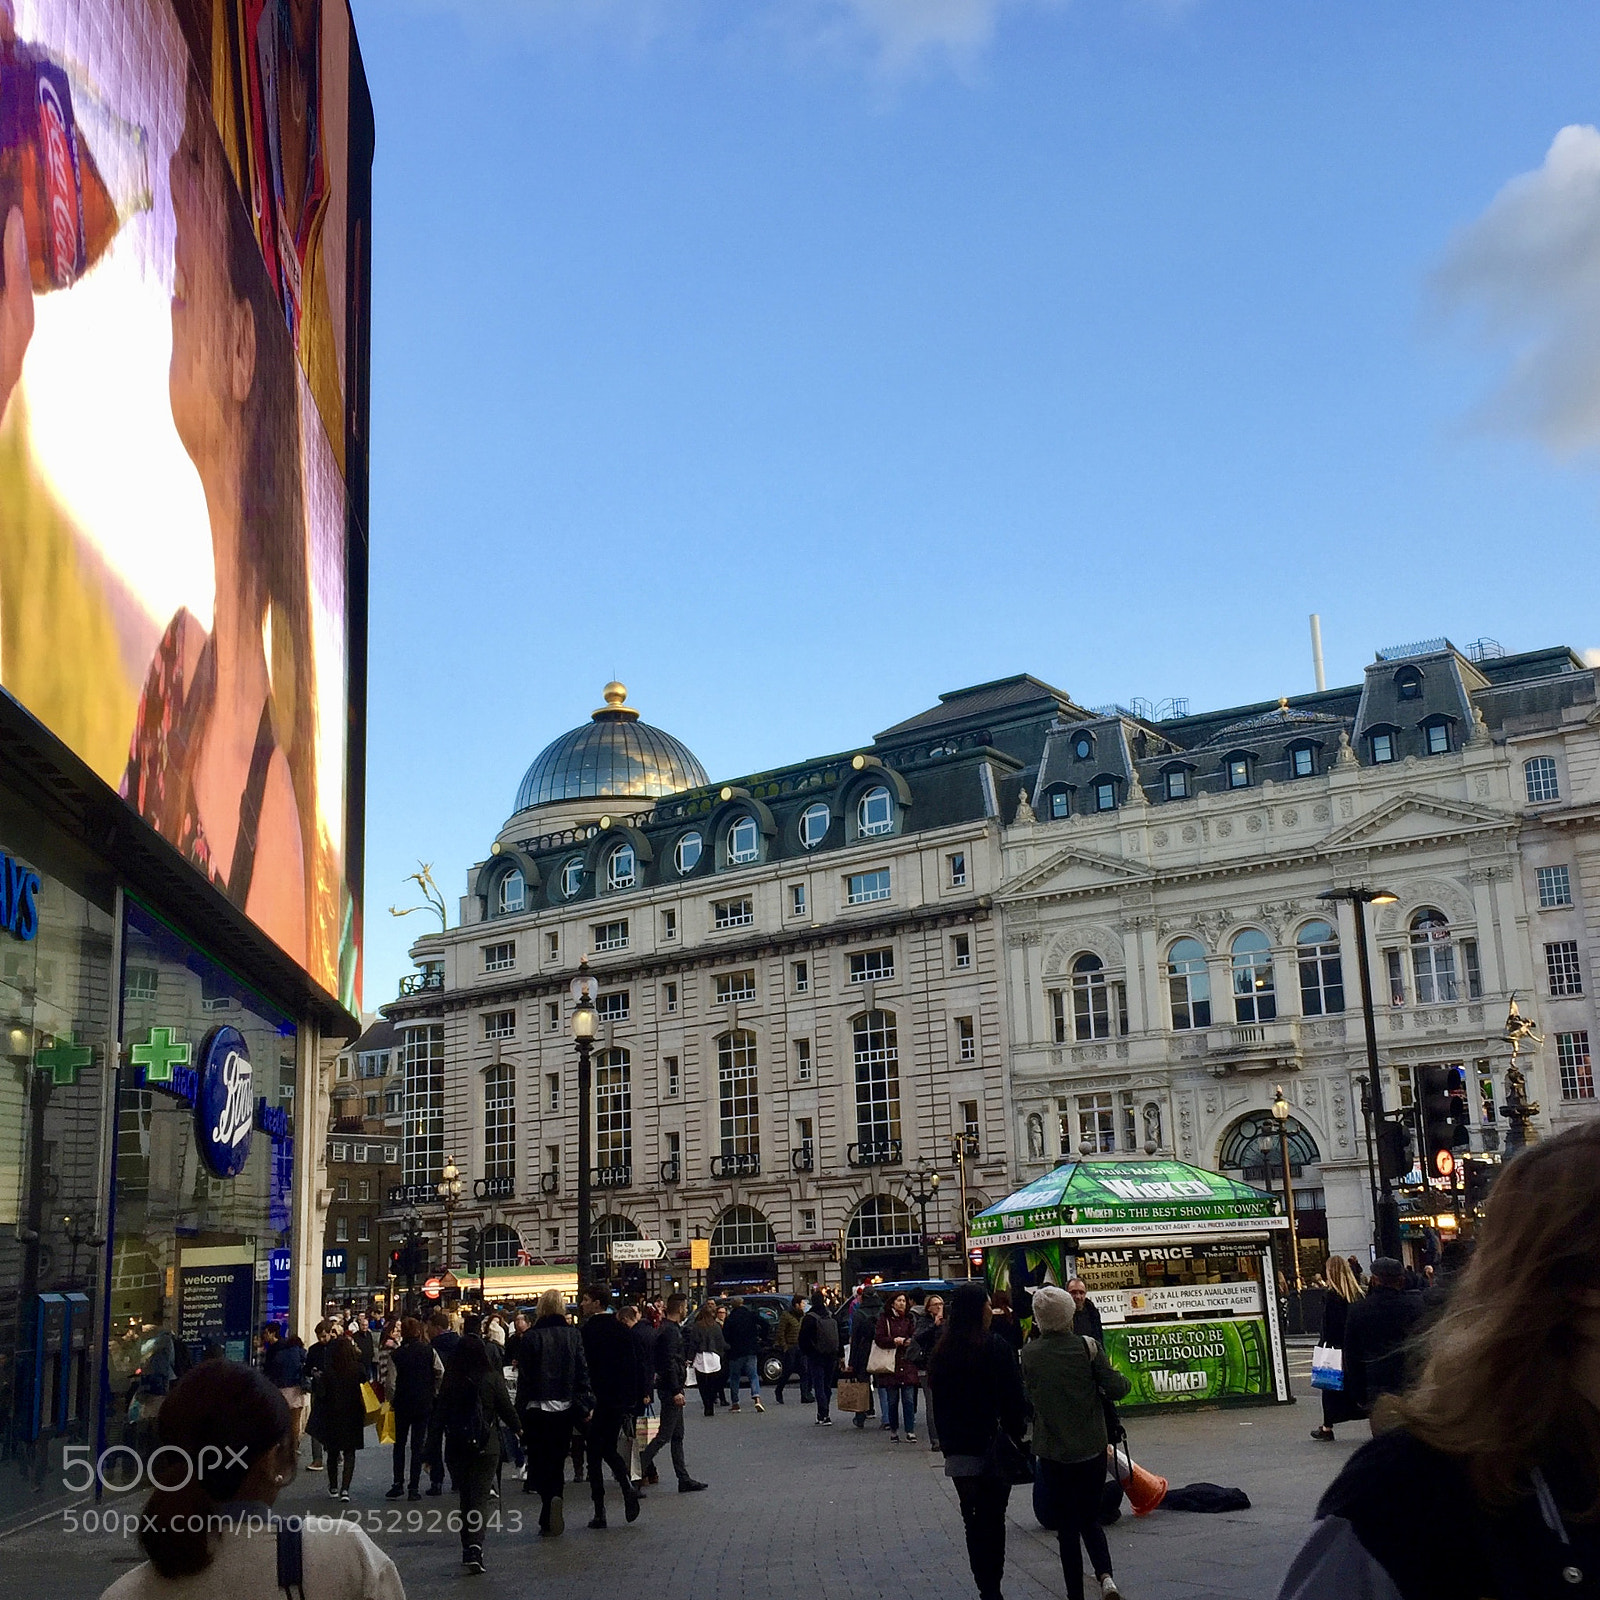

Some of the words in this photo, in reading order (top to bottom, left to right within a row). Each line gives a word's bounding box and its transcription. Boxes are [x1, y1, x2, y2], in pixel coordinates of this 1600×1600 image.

[1116, 1208, 1126, 1219] IS
[1128, 1207, 1149, 1218] THE
[1152, 1206, 1178, 1217] BEST
[1180, 1205, 1211, 1217] SHOW
[1214, 1205, 1225, 1215] IN
[969, 1236, 994, 1247] TICKETS
[999, 1235, 1011, 1243] FOR
[1016, 1232, 1027, 1240] ALL
[1032, 1229, 1056, 1238] SHOWS
[326, 1254, 343, 1268] GAP
[1084, 1250, 1133, 1263] HALF
[1138, 1246, 1194, 1260] PRICE
[183, 1274, 235, 1285] welcome
[1101, 1270, 1118, 1279] HERE
[1095, 1295, 1114, 1304] WEST
[1167, 1291, 1179, 1299] ALL
[1180, 1289, 1203, 1298] PRICES
[1204, 1286, 1239, 1296] AVAILABLE
[1240, 1286, 1257, 1294] HERE
[1177, 1299, 1206, 1309] OFFICIAL
[1206, 1298, 1229, 1306] TICKET
[1231, 1296, 1253, 1304] AGENT
[205, 1318, 223, 1326] drink
[182, 1329, 199, 1337] baby
[1127, 1331, 1184, 1348] PREPARE
[1187, 1331, 1205, 1343] TO
[1208, 1329, 1224, 1341] BE
[1129, 1343, 1226, 1364] SPELLBOUND
